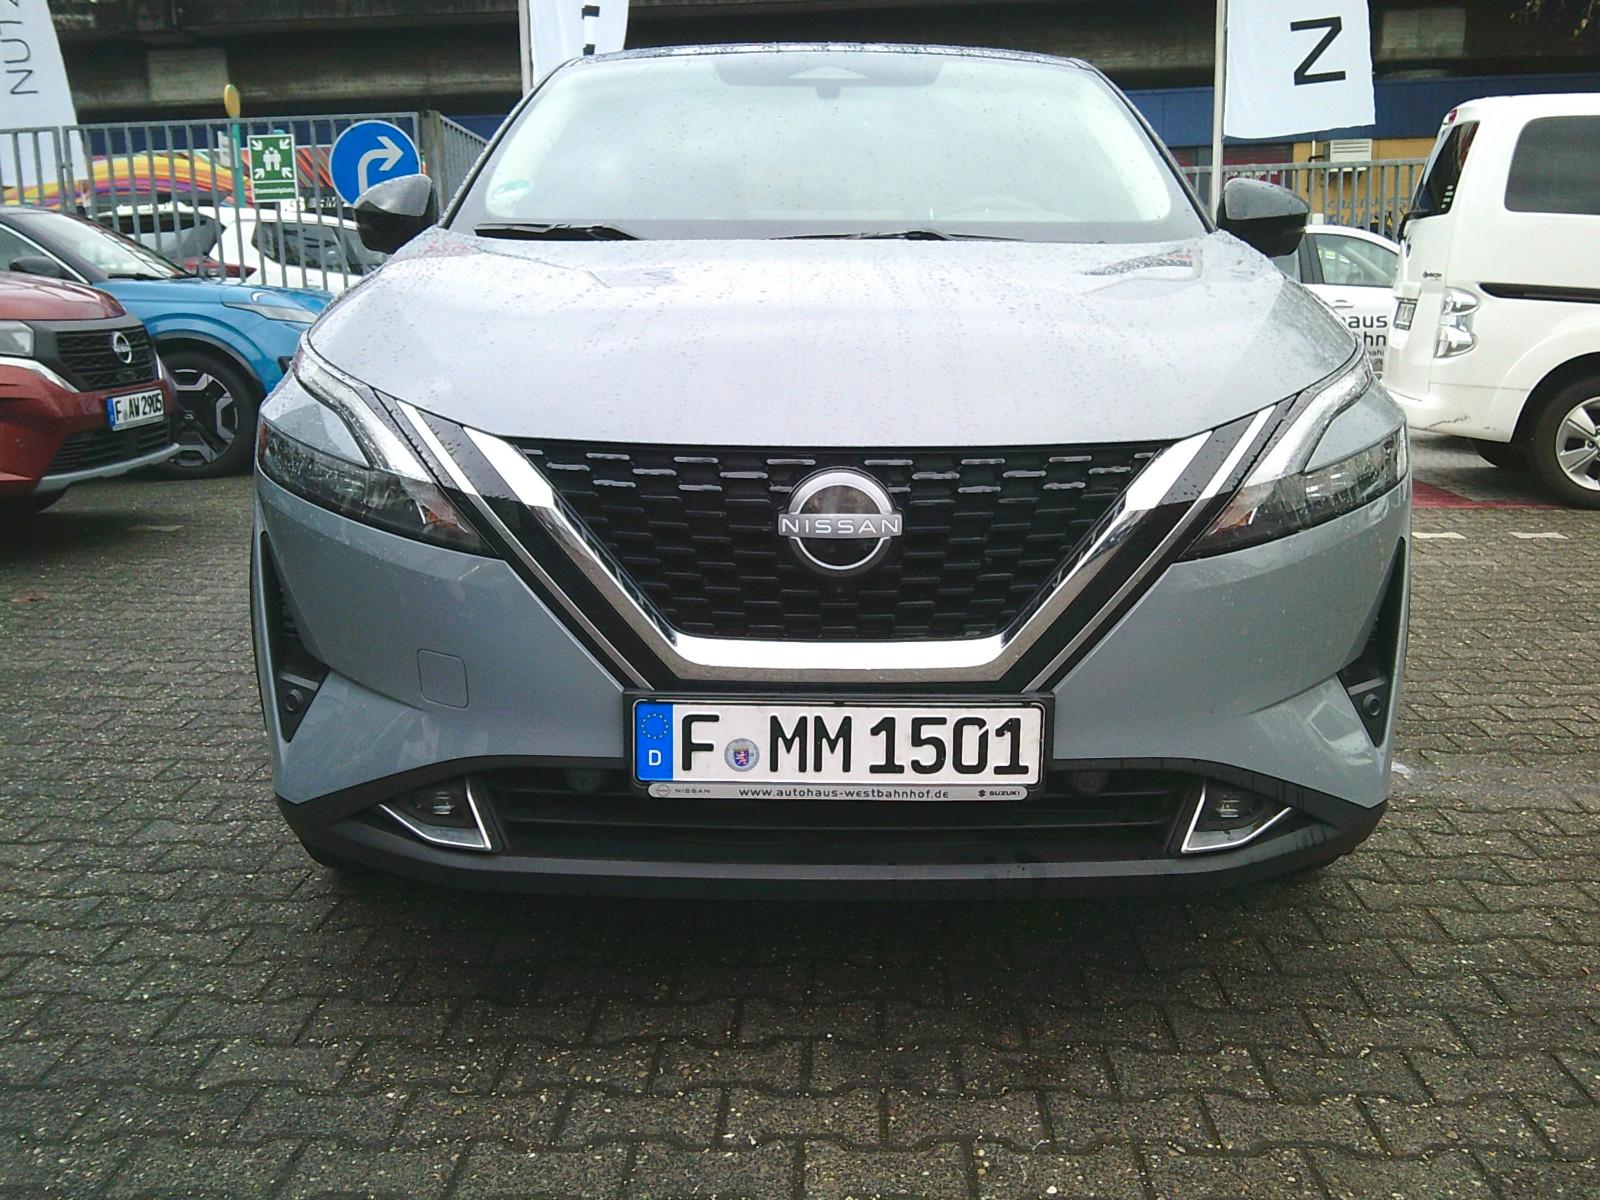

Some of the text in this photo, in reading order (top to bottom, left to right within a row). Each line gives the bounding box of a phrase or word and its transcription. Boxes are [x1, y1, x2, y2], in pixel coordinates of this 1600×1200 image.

[0, 0, 39, 95] NUT
[1341, 315, 1388, 329] aus
[114, 400, 122, 421] F
[128, 397, 140, 419] AW
[140, 393, 163, 416] 2905
[781, 518, 898, 534] NISSAN
[681, 714, 1029, 775] F MM 1501
[648, 749, 662, 766] D
[739, 787, 949, 799] www.autohaus-westbahnhof.de
